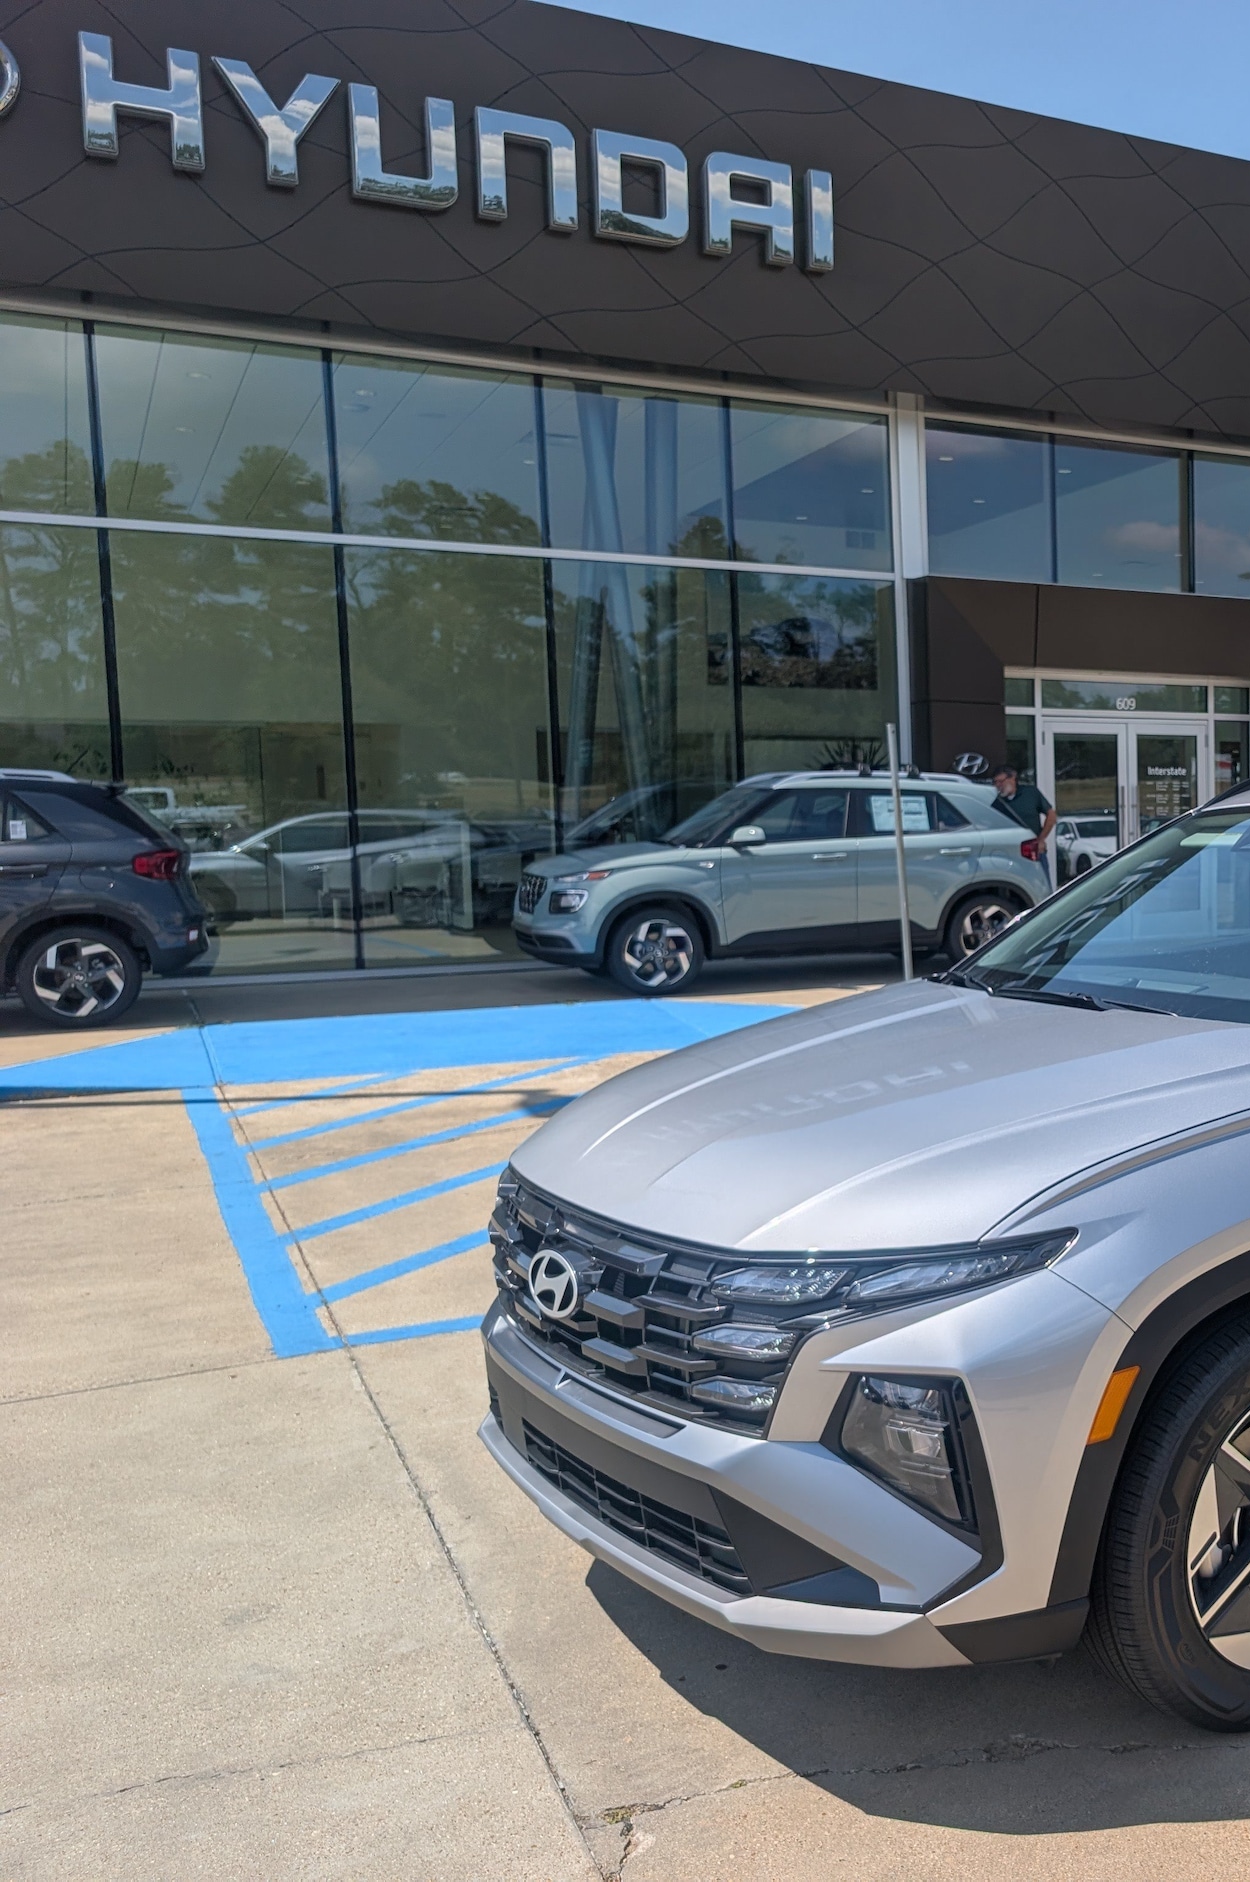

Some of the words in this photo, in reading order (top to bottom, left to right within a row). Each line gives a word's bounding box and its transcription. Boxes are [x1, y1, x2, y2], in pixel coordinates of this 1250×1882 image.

[78, 30, 835, 274] HYUNDAI
[1116, 698, 1136, 710] 609
[1147, 766, 1187, 776] Interstate
